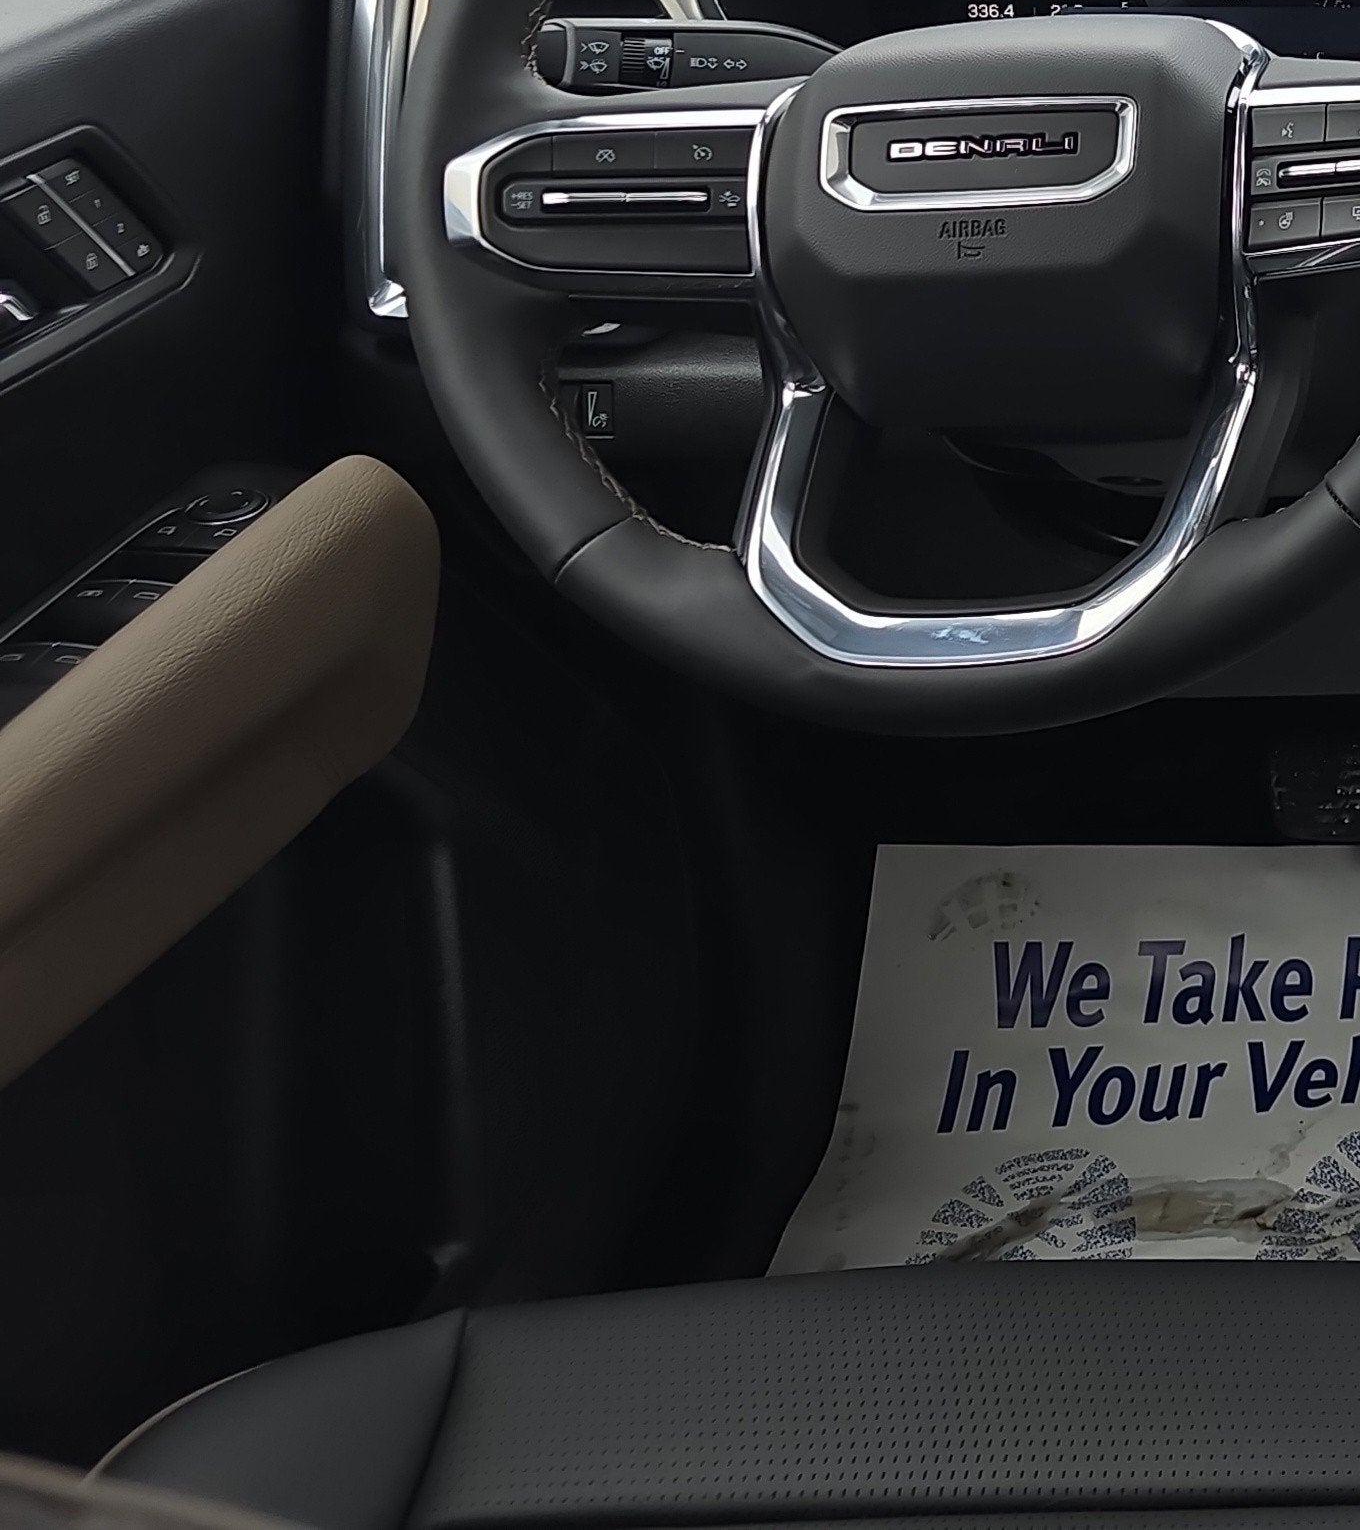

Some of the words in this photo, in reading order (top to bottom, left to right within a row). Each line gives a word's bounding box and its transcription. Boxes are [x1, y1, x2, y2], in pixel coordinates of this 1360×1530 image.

[967, 3, 1015, 18] 336.4
[654, 46, 671, 56] OFF
[889, 133, 1075, 161] DENALI
[938, 219, 1007, 239] AIRBAG
[994, 937, 1111, 1030] We
[1137, 931, 1314, 1026] Take
[936, 1049, 1018, 1134] In
[1047, 1041, 1228, 1129] Your
